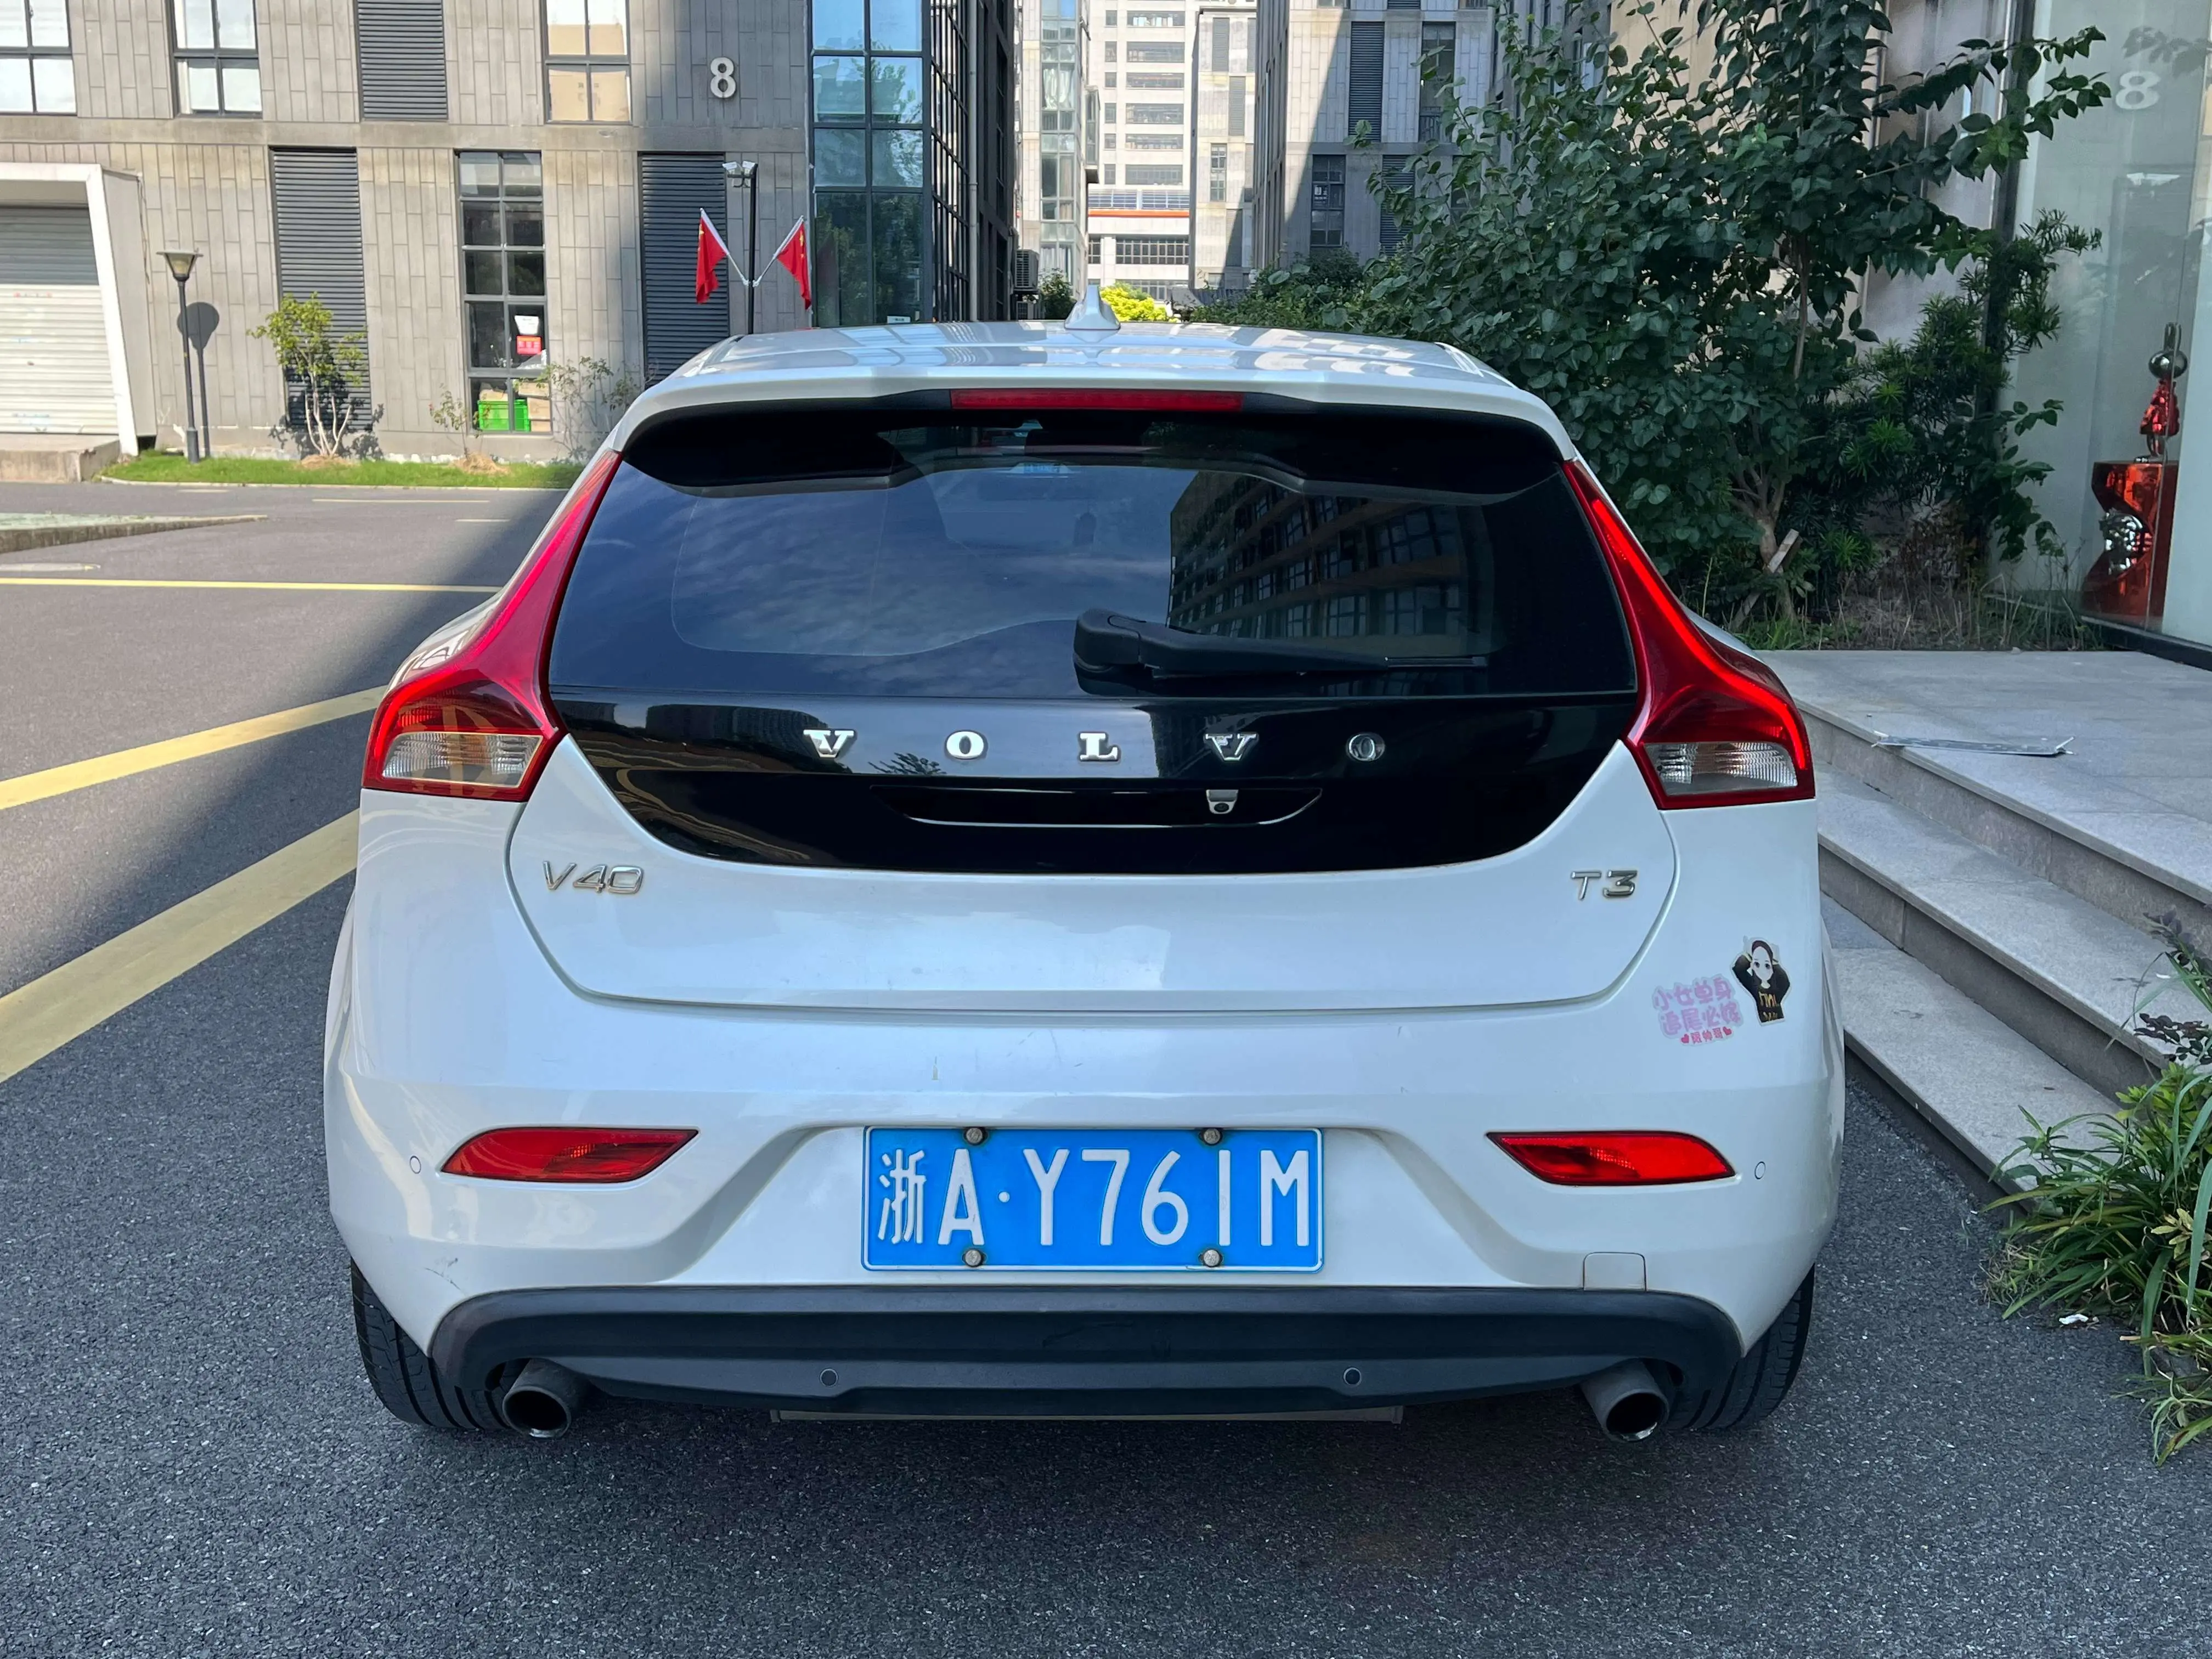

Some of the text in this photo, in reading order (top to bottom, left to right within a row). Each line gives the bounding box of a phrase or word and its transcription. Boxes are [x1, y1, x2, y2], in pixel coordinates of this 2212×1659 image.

[710, 57, 736, 98] 8
[803, 729, 1386, 762] VOLVO
[543, 860, 644, 895] V40
[1570, 870, 1638, 901] T3
